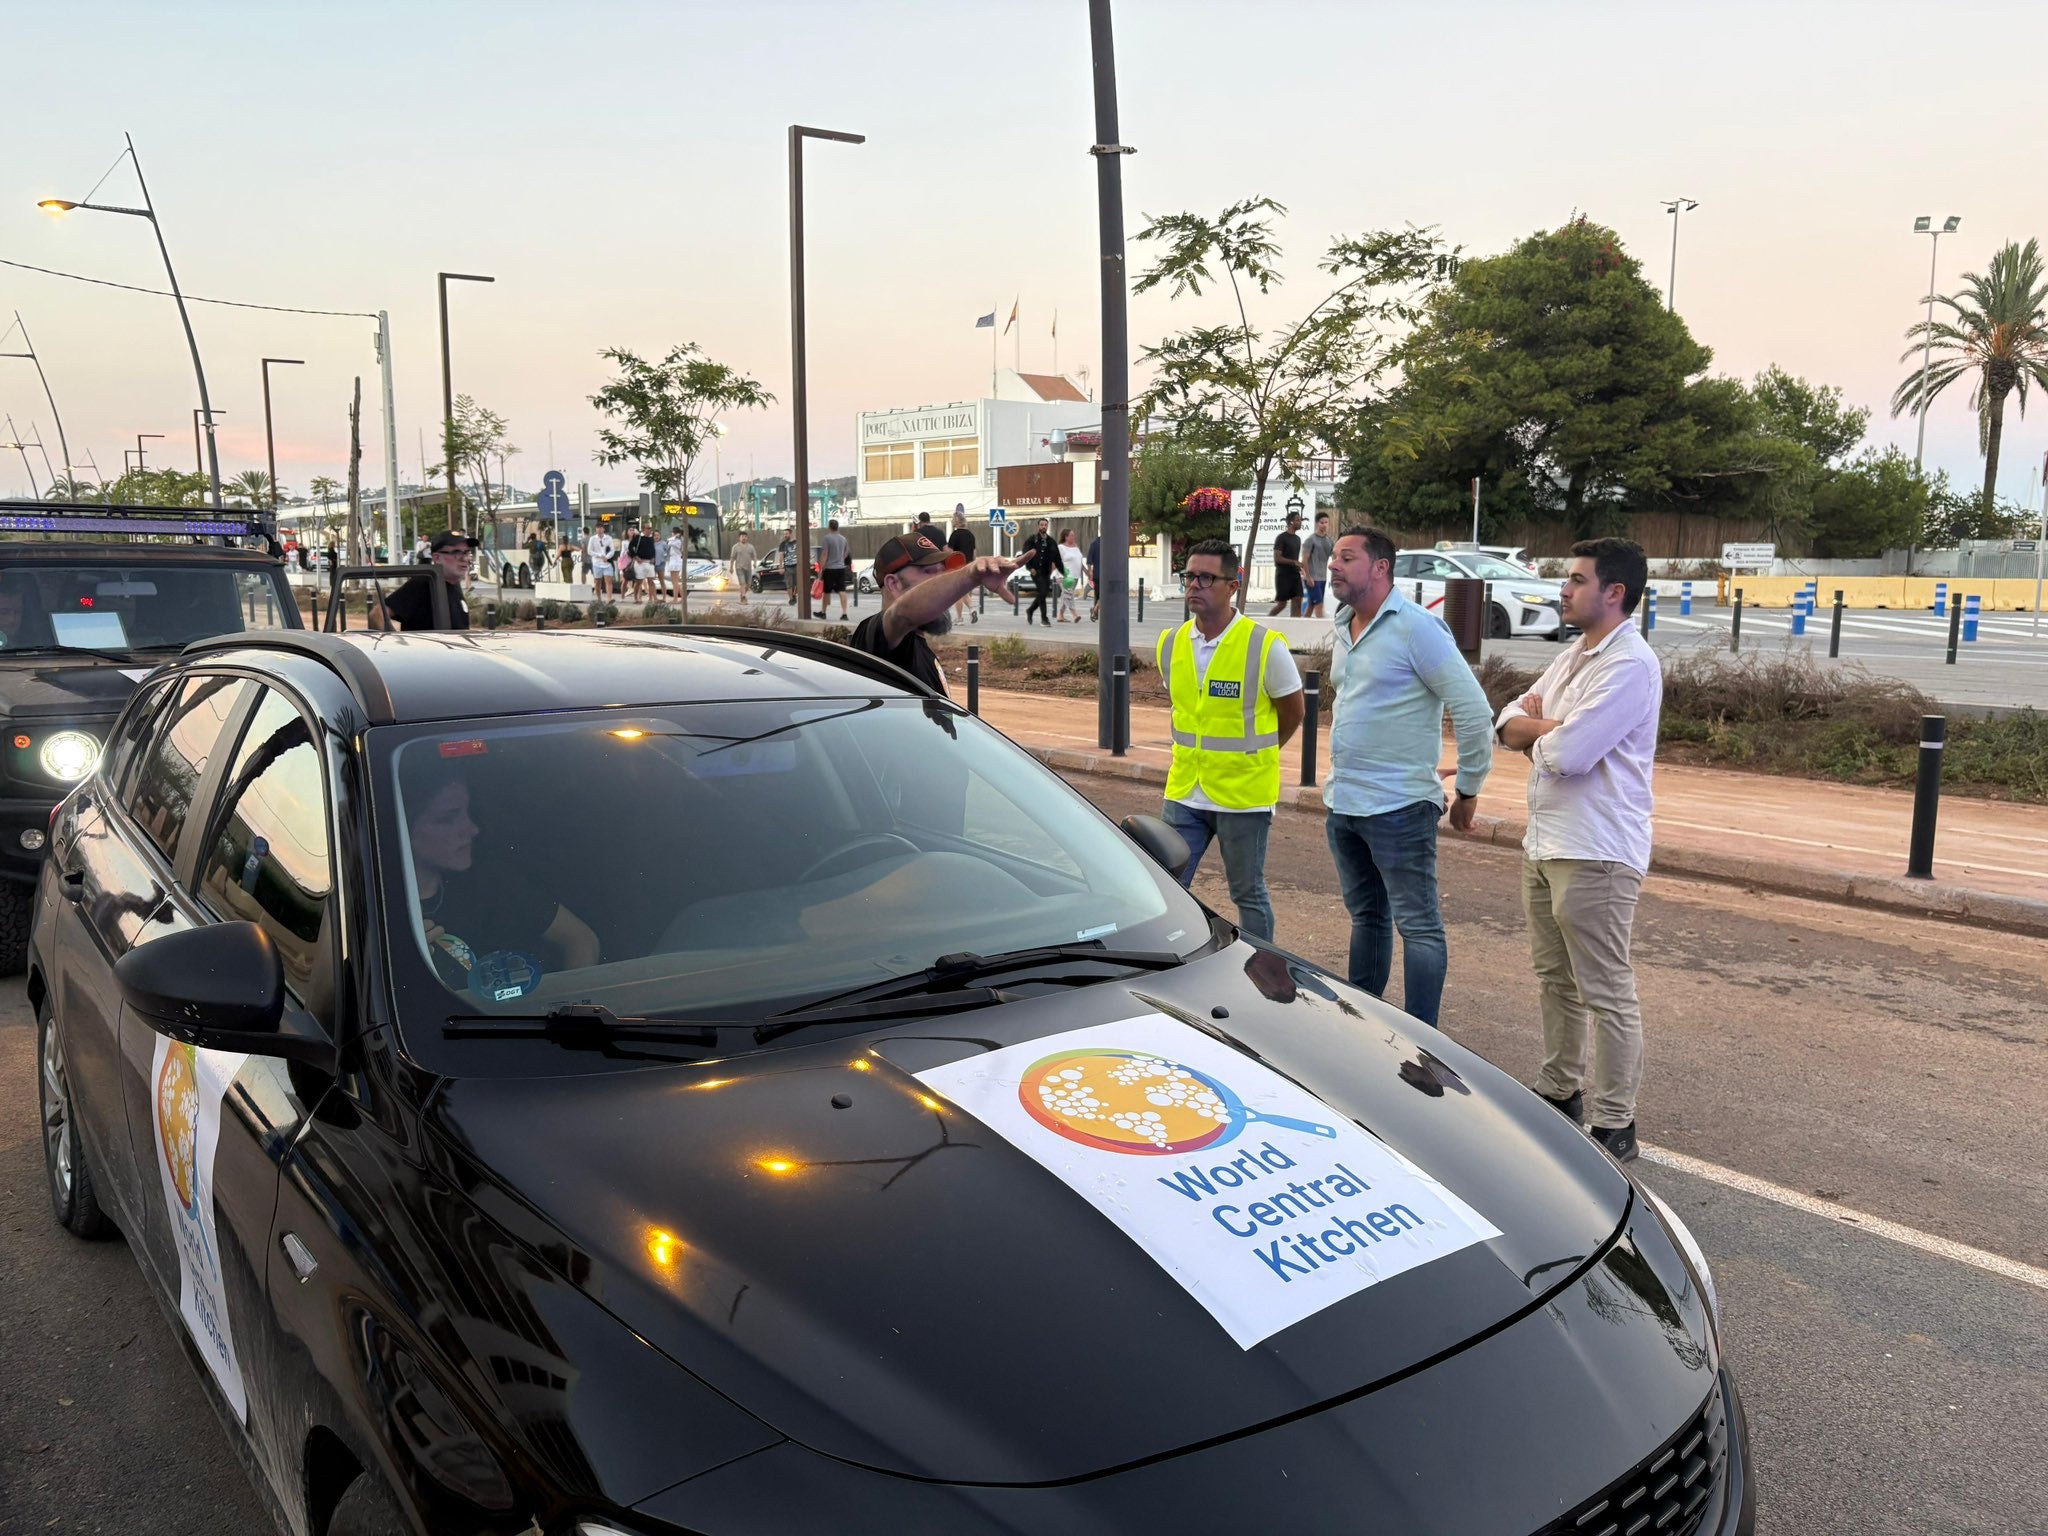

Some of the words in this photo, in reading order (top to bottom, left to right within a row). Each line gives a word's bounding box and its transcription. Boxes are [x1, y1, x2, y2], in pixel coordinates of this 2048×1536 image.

[865, 422, 888, 438] PORT
[902, 416, 941, 433] NAUTIC
[943, 413, 973, 429] IBIZA
[1002, 498, 1011, 506] LA
[1016, 497, 1042, 505] TERRAZA
[1043, 496, 1052, 504] DE
[1210, 681, 1239, 690] POLICIA
[1217, 688, 1238, 697] LOCAL
[1156, 1141, 1298, 1202] World
[1212, 1163, 1371, 1238] Central
[1253, 1203, 1425, 1283] Kitchen
[192, 1280, 232, 1374] Kitchen
